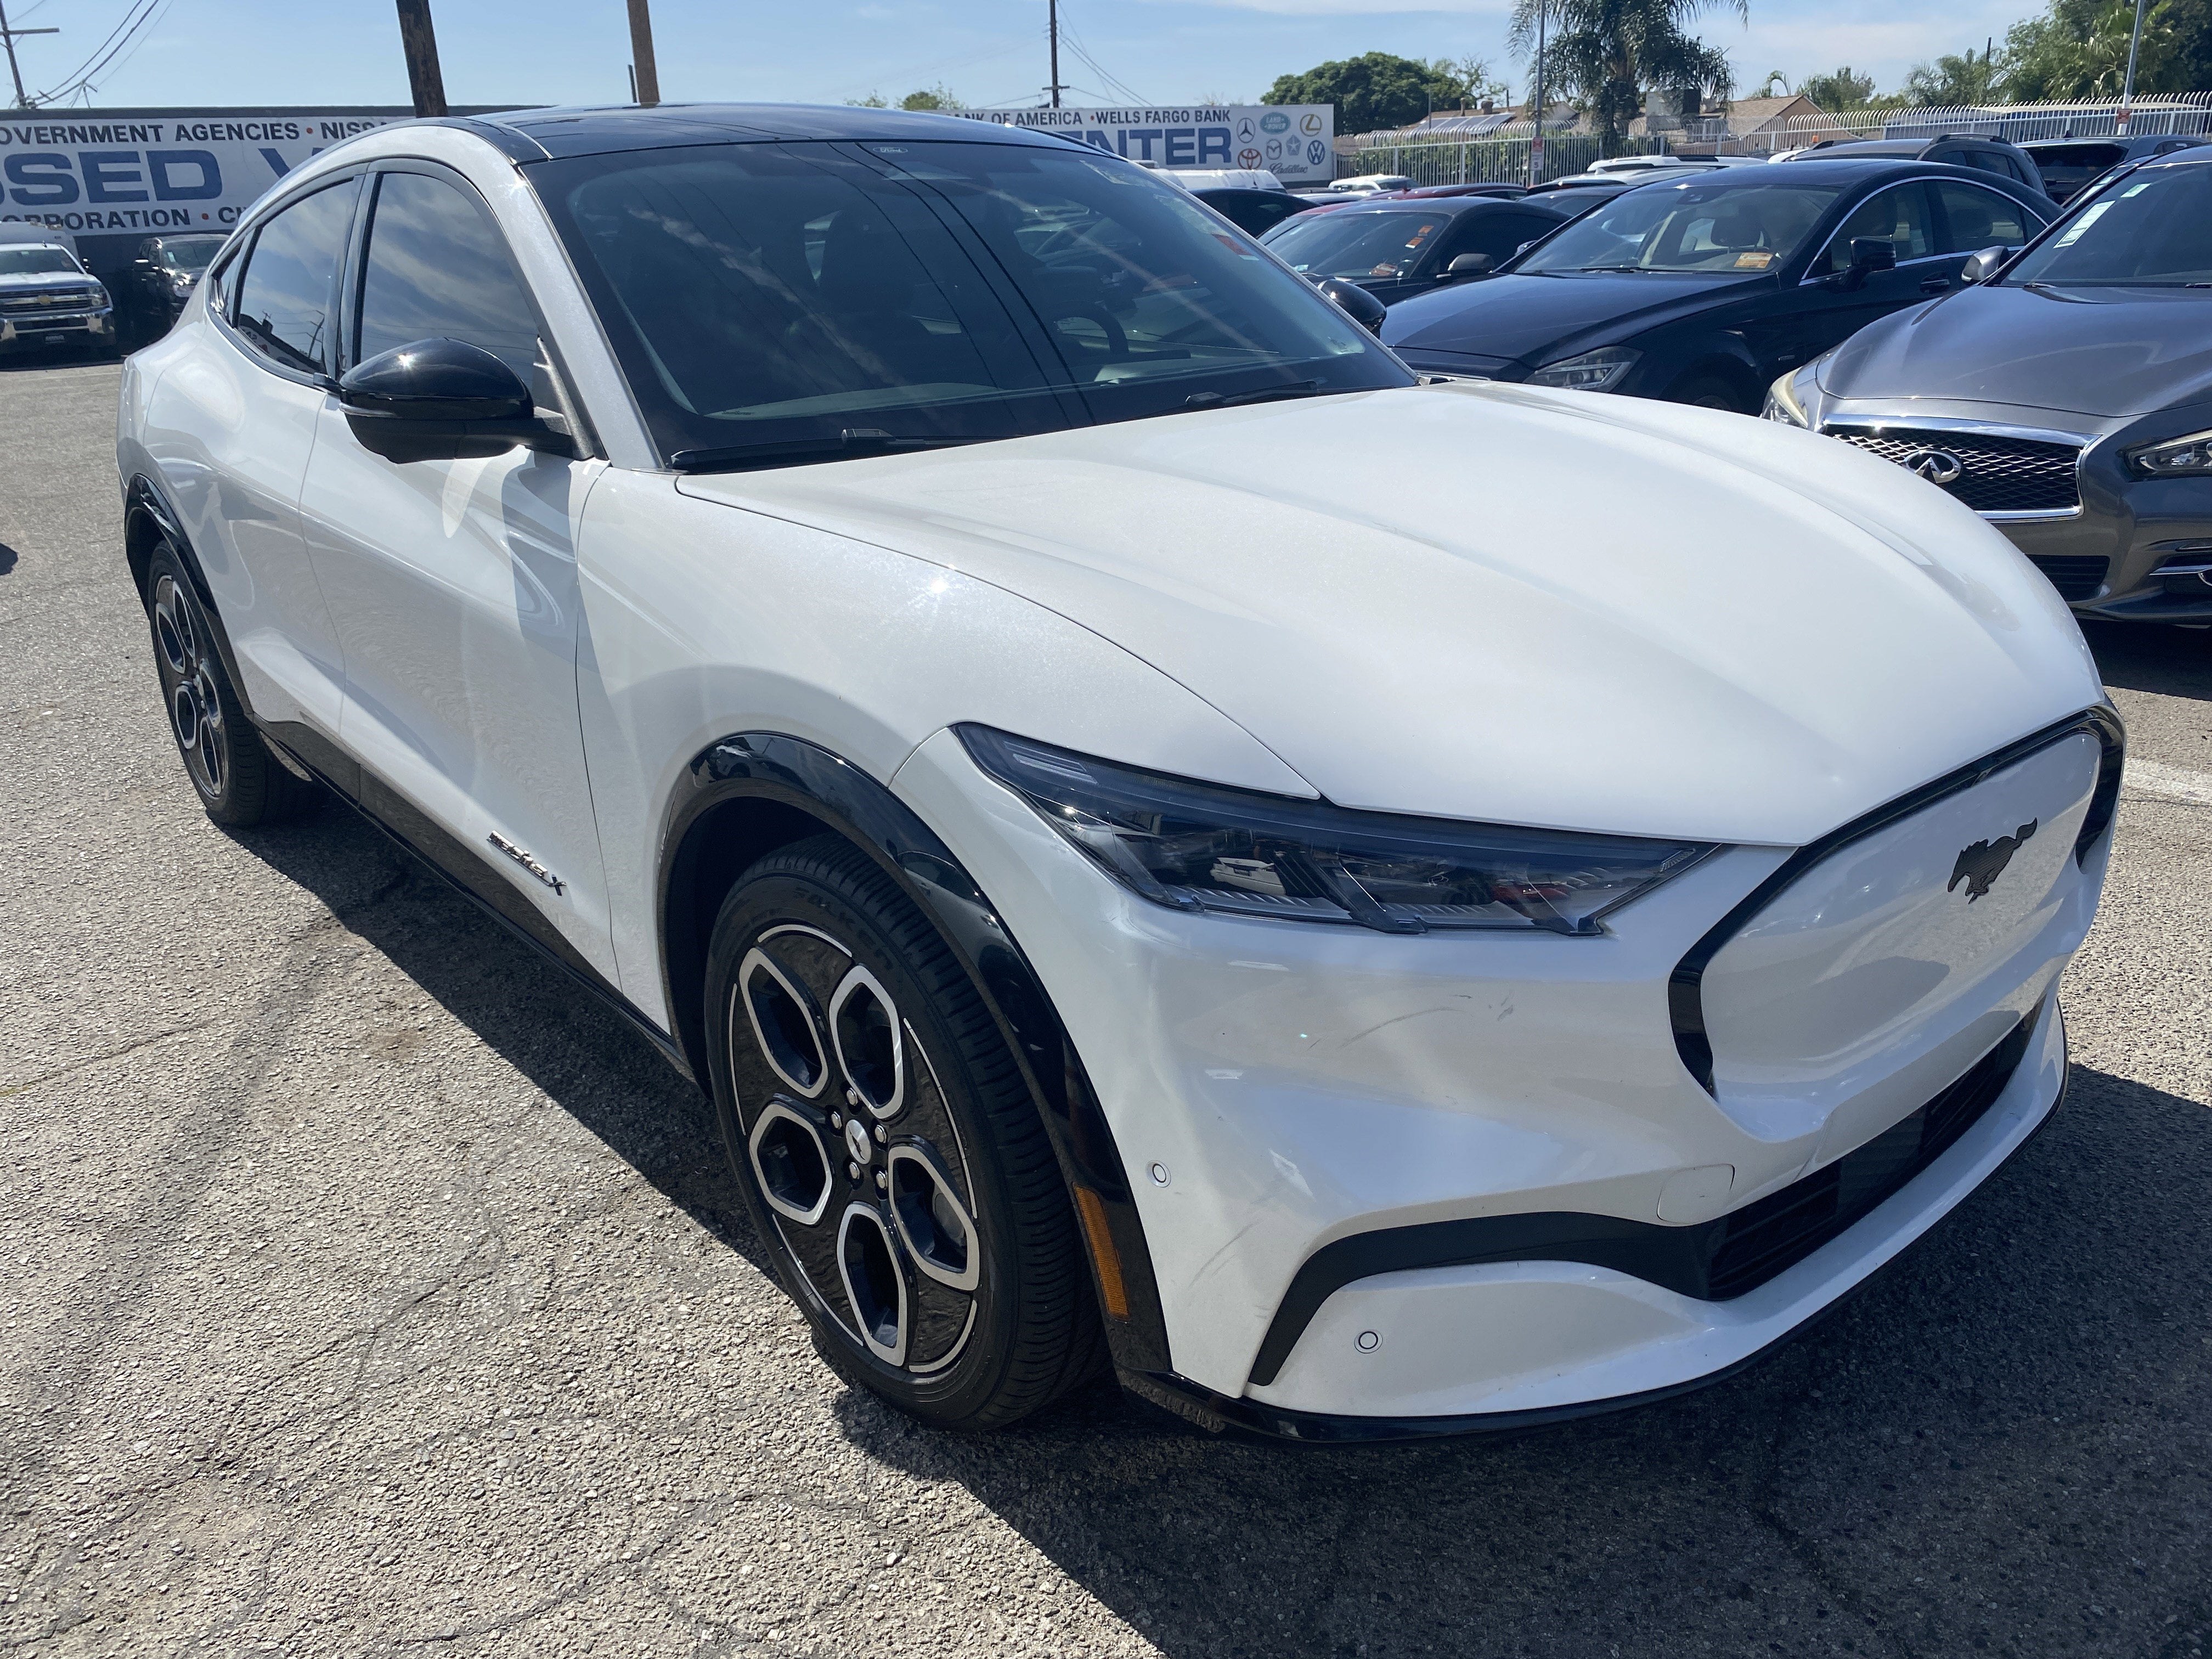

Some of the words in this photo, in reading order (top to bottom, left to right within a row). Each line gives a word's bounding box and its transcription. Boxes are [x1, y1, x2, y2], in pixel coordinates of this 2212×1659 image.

[991, 112, 1010, 125] OF
[1015, 111, 1083, 126] AMERICA
[1096, 111, 1141, 124] WELLS
[1146, 110, 1190, 123] FARGO
[1195, 109, 1231, 123] BANK
[175, 122, 301, 142] AGENCIES
[320, 121, 387, 140] NIS
[1053, 127, 1232, 165] NTER
[0, 149, 223, 206] SED
[1269, 162, 1308, 175] Cadillac
